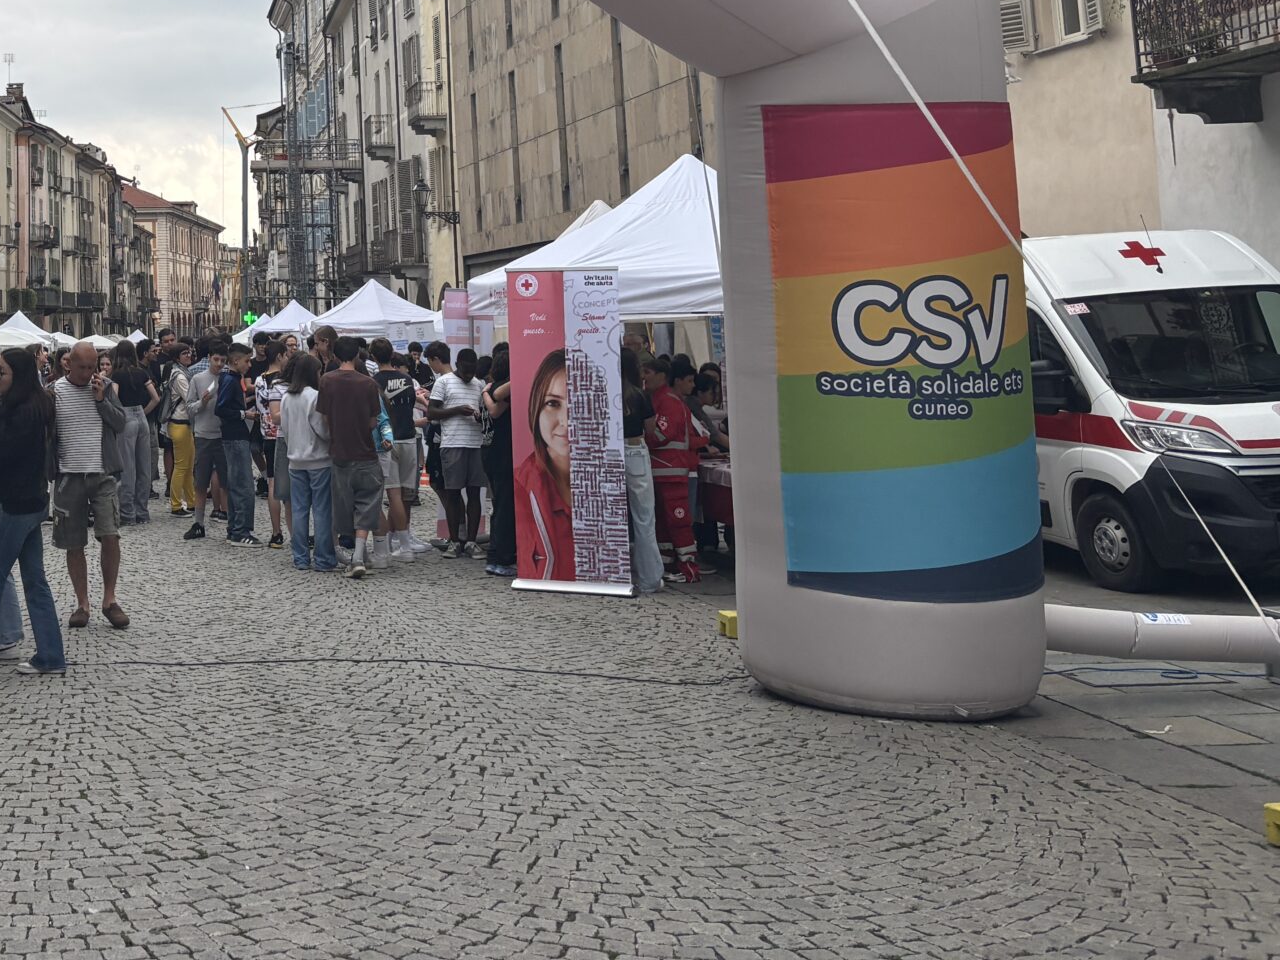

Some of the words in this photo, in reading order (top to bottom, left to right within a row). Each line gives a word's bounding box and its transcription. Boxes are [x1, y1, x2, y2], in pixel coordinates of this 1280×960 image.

[529, 312, 548, 322] Vedi
[581, 312, 607, 322] Siamo
[387, 378, 407, 391] NIKE
[819, 372, 912, 395] società
[920, 372, 1000, 395] solidale
[1003, 371, 1024, 393] ets
[911, 402, 970, 417] cuneo
